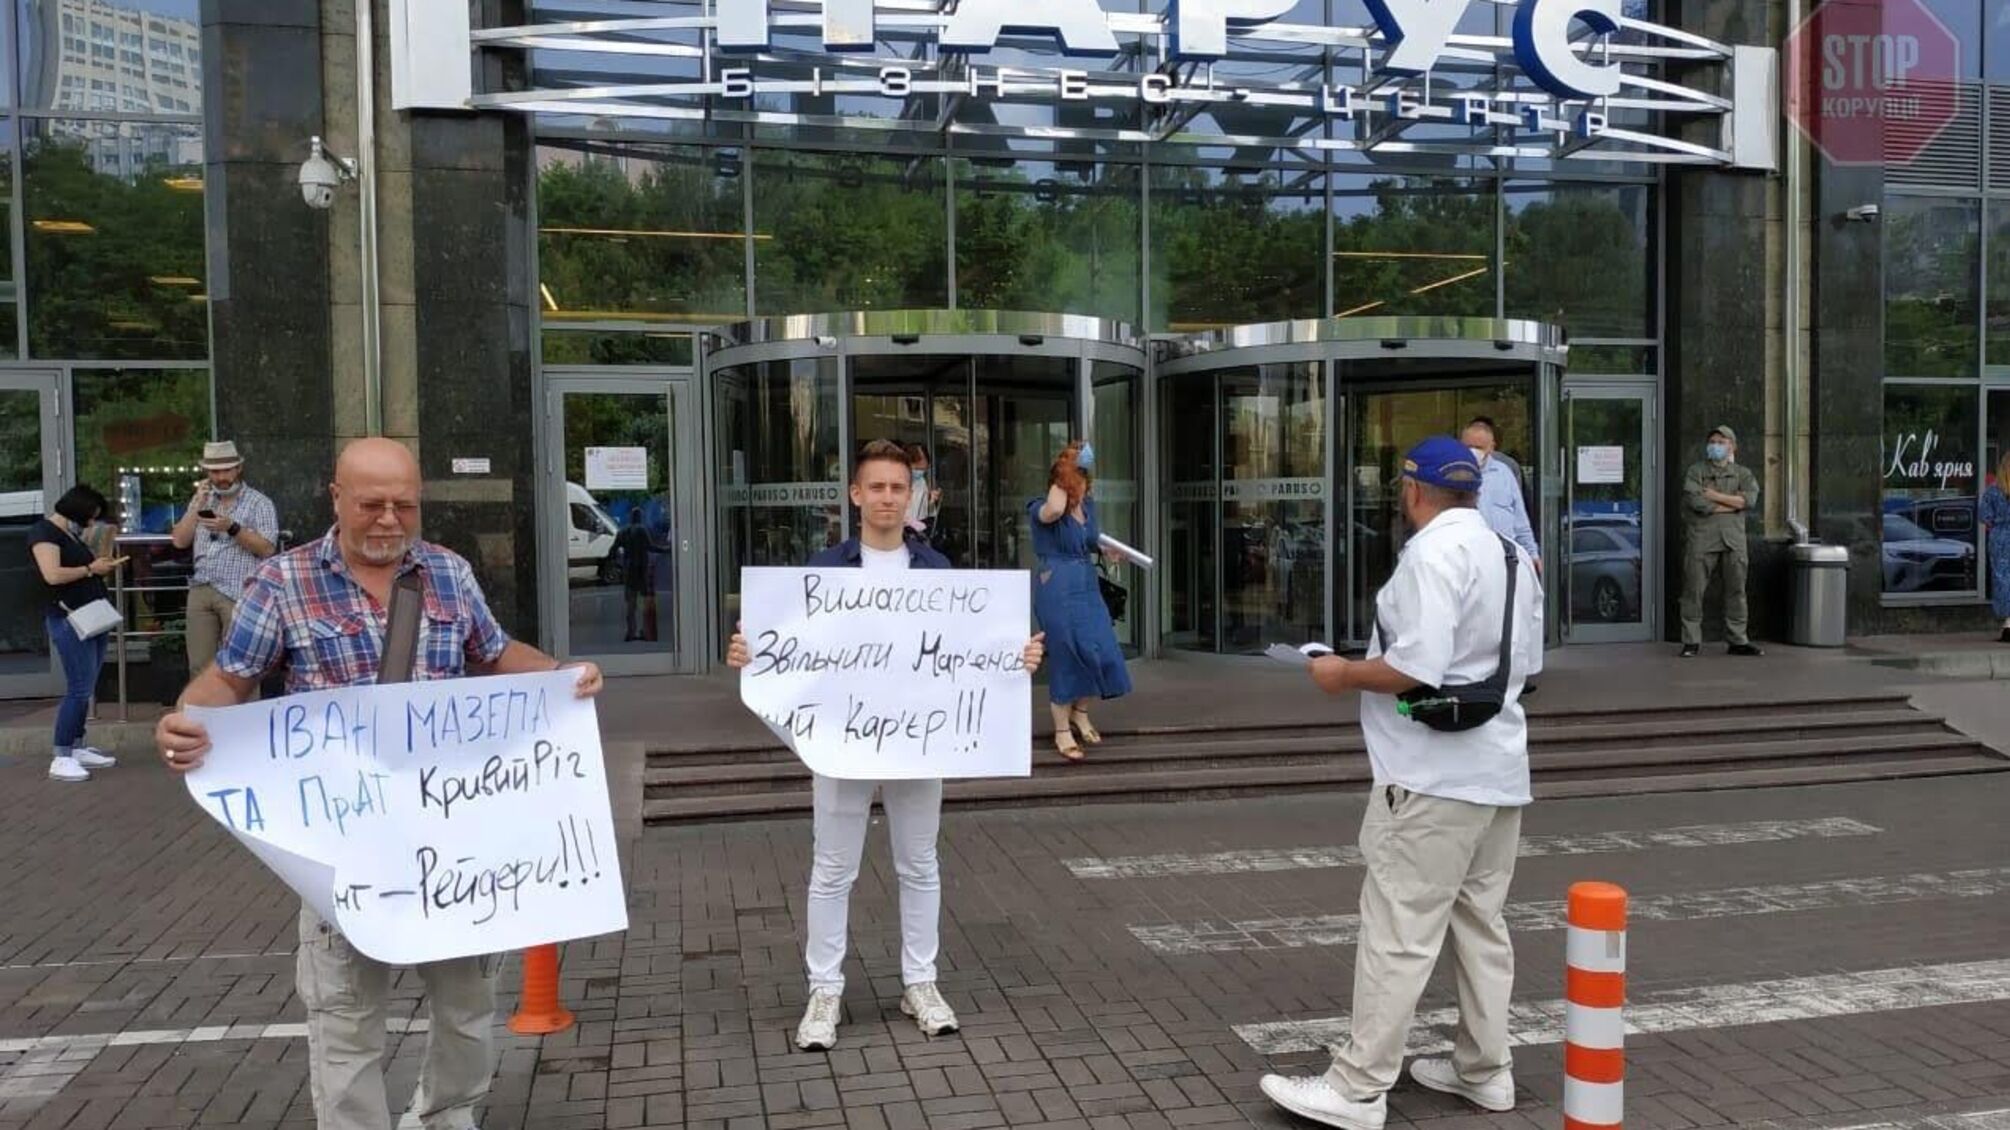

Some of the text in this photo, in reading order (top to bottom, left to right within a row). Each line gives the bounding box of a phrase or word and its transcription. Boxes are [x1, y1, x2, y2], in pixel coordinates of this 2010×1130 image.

[1883, 428, 1974, 491] Кав'ярня
[804, 573, 989, 618] Вимагаємо
[269, 687, 551, 760] ІВАН МАЗЕПА
[207, 786, 265, 832] ТА
[299, 768, 391, 836] ПрАТ
